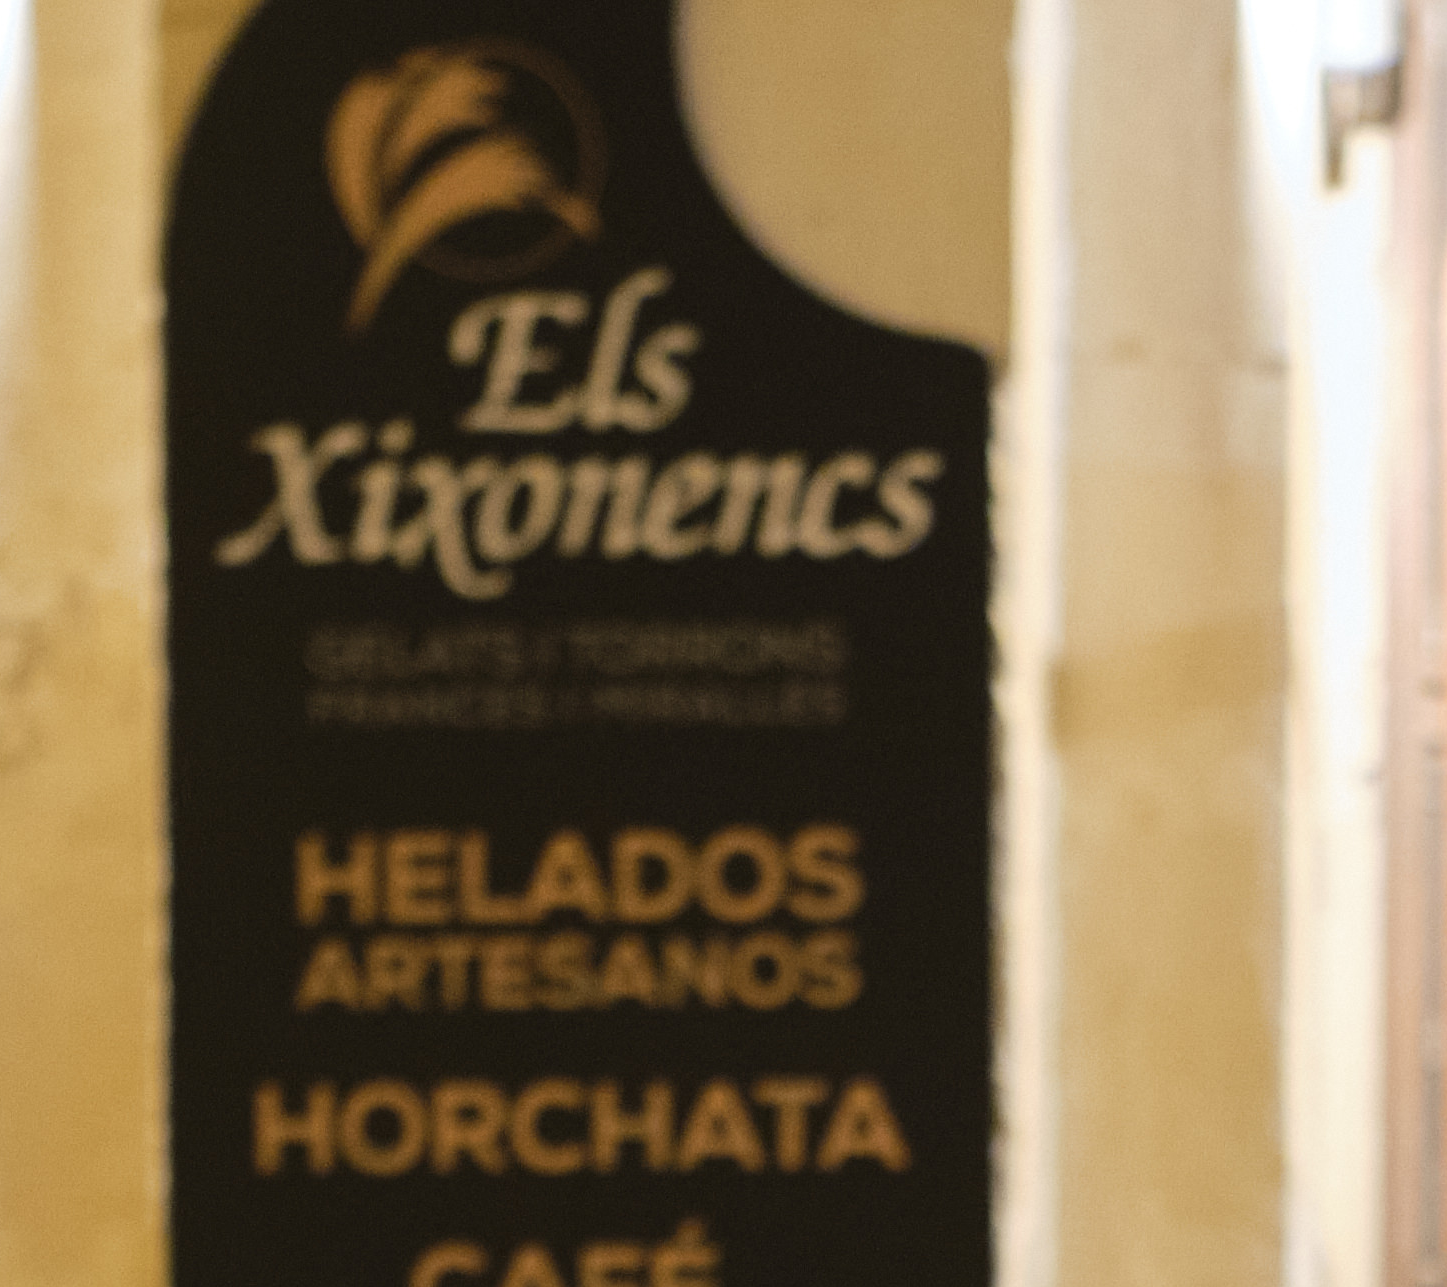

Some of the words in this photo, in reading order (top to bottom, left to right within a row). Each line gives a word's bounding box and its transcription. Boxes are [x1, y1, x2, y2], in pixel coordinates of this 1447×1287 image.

[449, 266, 701, 434] Els
[213, 418, 944, 600] Xixonencs
[294, 826, 866, 925] HELADOS
[294, 932, 866, 1012] ARTESANOS
[251, 1079, 911, 1177] HORCHATA
